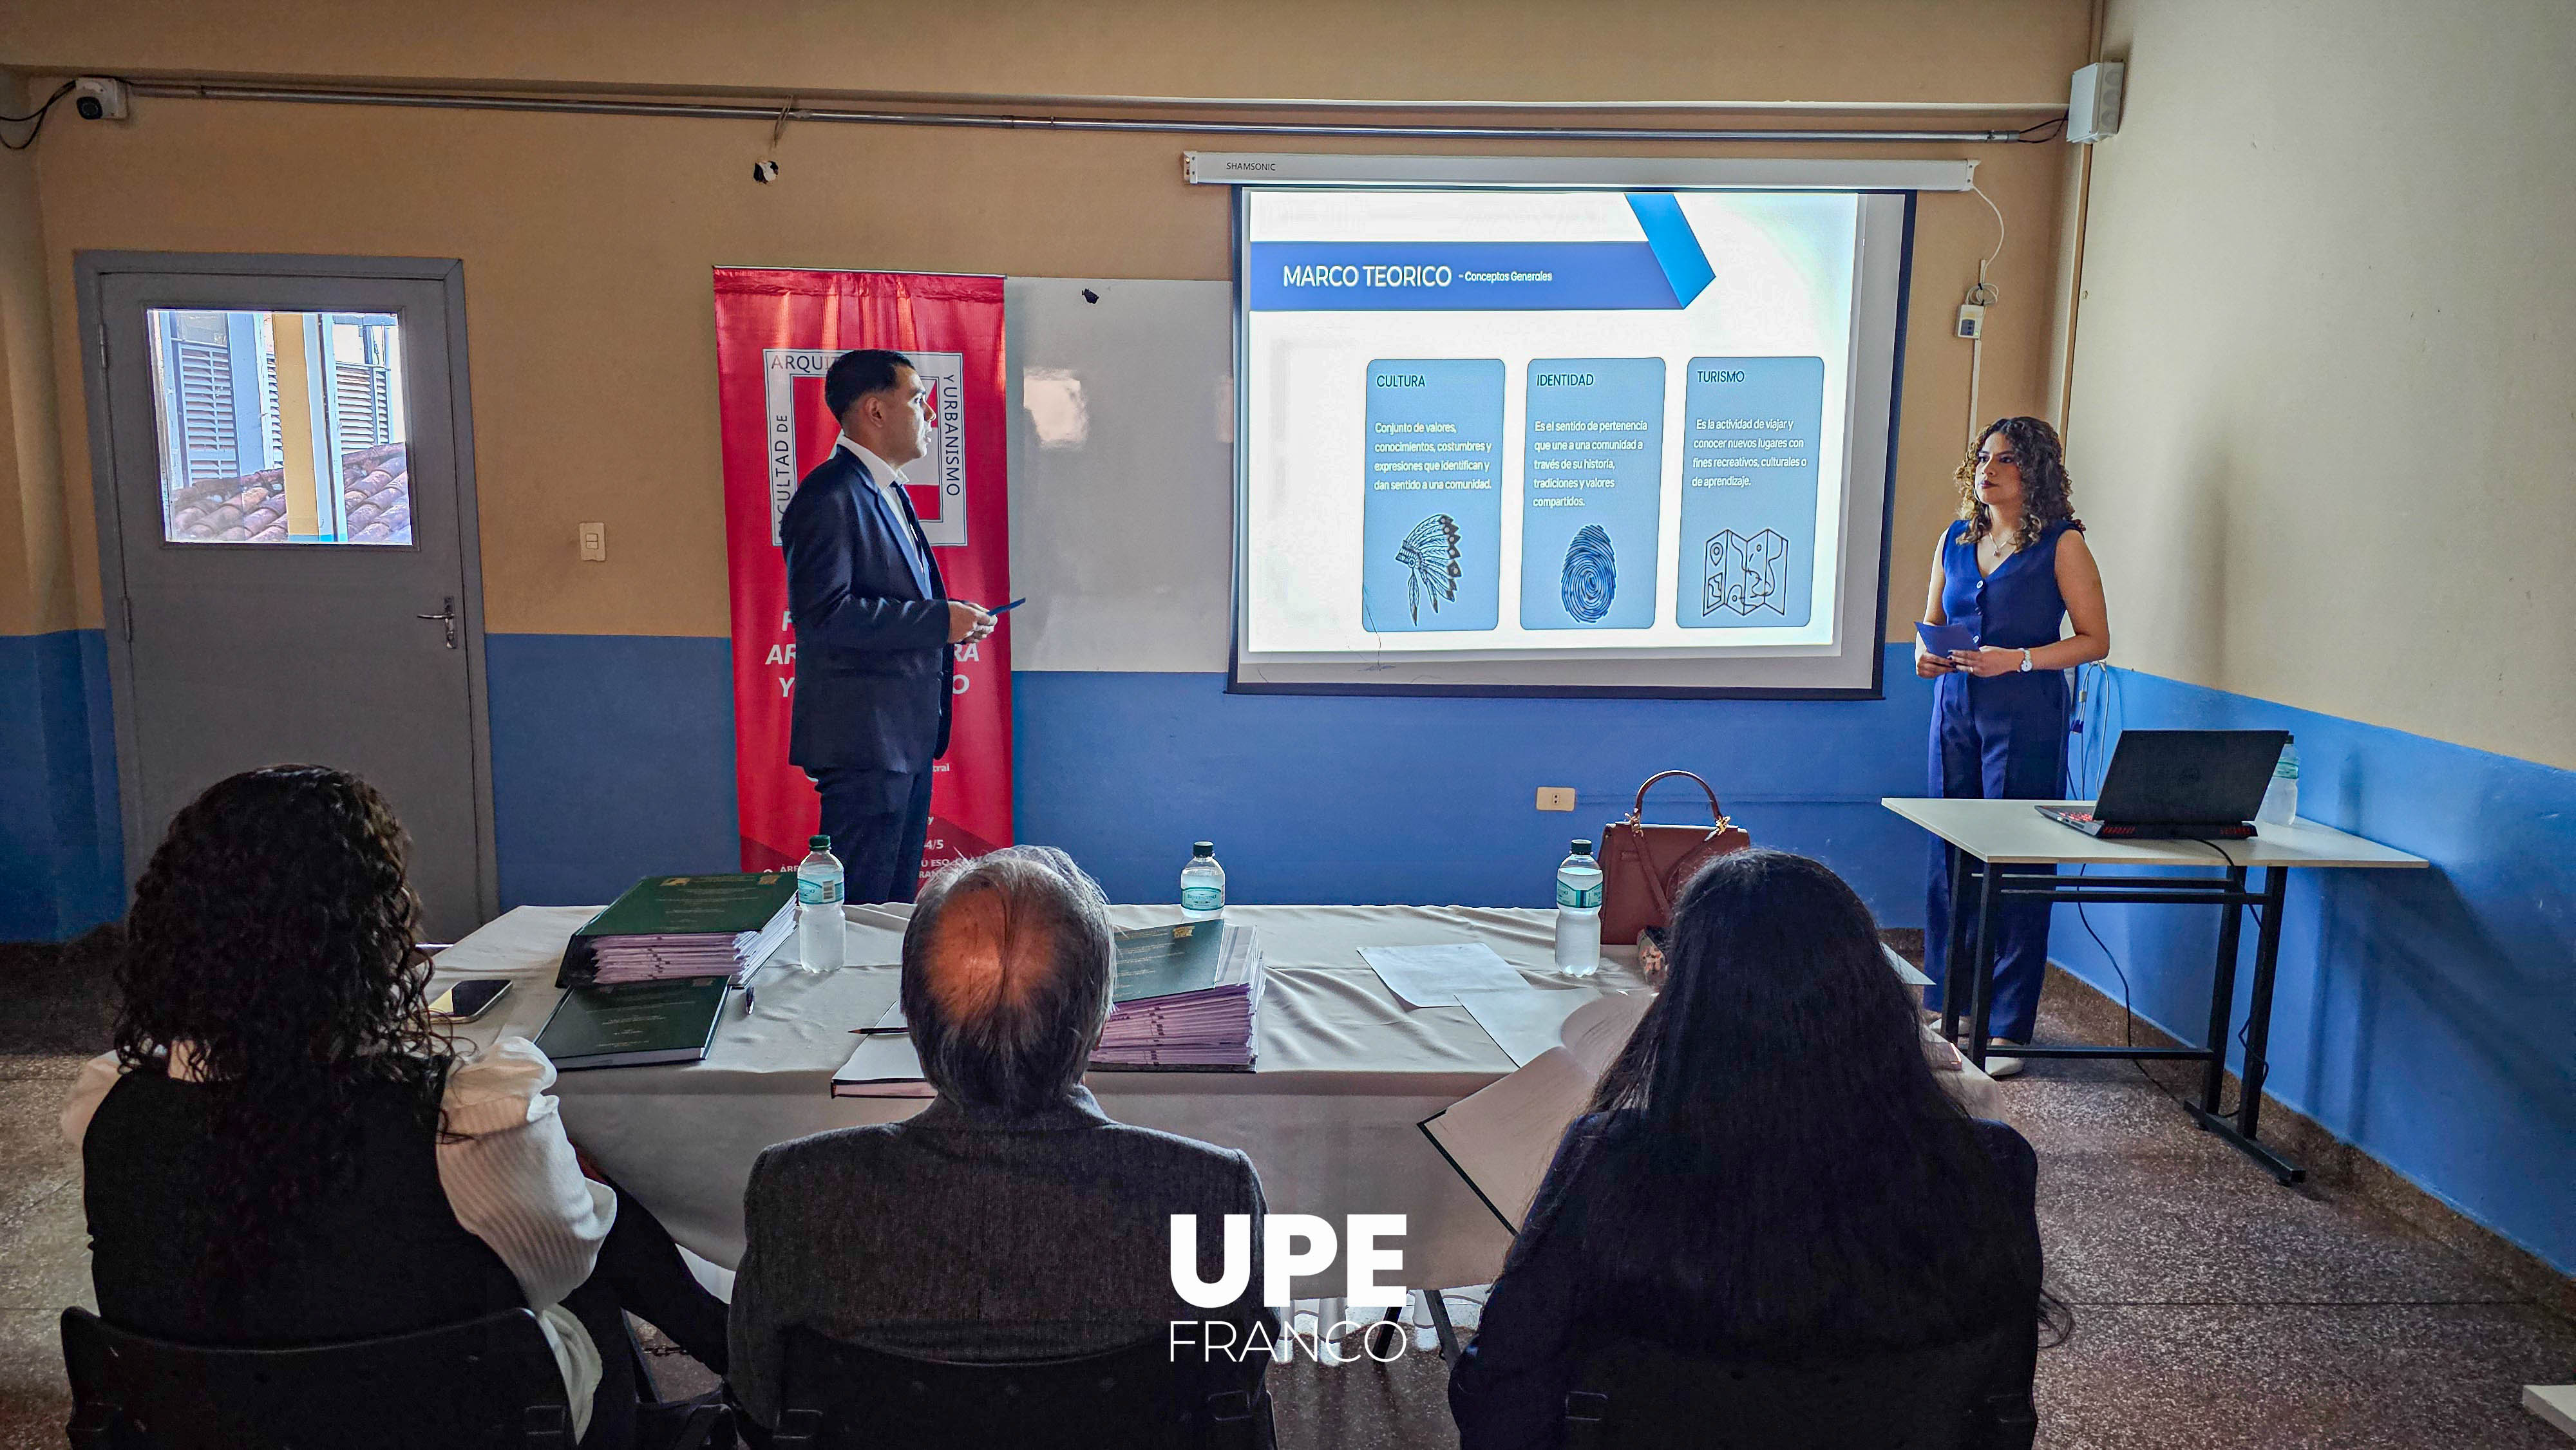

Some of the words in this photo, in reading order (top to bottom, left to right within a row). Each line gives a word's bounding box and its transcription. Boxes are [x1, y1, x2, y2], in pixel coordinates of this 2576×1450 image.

[1226, 162, 1276, 171] SHAMSONIC
[1283, 265, 1358, 287] MARCO
[1363, 265, 1452, 287] TEORICO
[1464, 270, 1510, 284] Conceptos
[1510, 270, 1552, 282] Generales
[1377, 375, 1425, 387] CULTURA
[1537, 374, 1594, 386] IDENTIDAD
[1698, 371, 1745, 382] TURISMO
[776, 415, 788, 433] DE
[1375, 422, 1412, 435] Conjunto
[1413, 422, 1425, 433] de
[1426, 422, 1457, 433] valores,
[1535, 421, 1545, 431] Es
[1546, 421, 1554, 431] el
[1555, 421, 1586, 431] sentido
[1587, 420, 1598, 431] de
[1599, 420, 1647, 433] pertenencia
[1696, 419, 1707, 429] Es
[1708, 419, 1715, 429] la
[1716, 419, 1752, 429] actividad
[1754, 419, 1765, 429] de
[1766, 419, 1787, 431] viajar
[1788, 420, 1794, 431] y
[943, 387, 960, 496] URBANISMO
[1375, 442, 1436, 453] conocimientos,
[1437, 442, 1485, 451] costumbres
[1486, 443, 1492, 453] y
[1535, 442, 1551, 452] que
[1552, 442, 1567, 450] une
[1569, 442, 1575, 450] a
[1575, 441, 1590, 450] una
[1591, 440, 1636, 449] comunidad
[1694, 439, 1727, 448] conocer
[1728, 439, 1757, 447] nuevos
[1758, 438, 1787, 450] lugares
[1788, 439, 1804, 447] con
[1374, 460, 1423, 473] expresiones
[1424, 462, 1440, 473] que
[1441, 460, 1483, 471] identifican
[1484, 462, 1490, 473] y
[1534, 458, 1560, 469] través
[1561, 459, 1572, 469] de
[1573, 460, 1583, 469] su
[1584, 458, 1615, 469] historia,
[1692, 457, 1712, 468] fines
[1714, 457, 1759, 468] recreativos,
[1761, 457, 1800, 467] culturales
[1801, 458, 1807, 467] o
[1374, 480, 1390, 490] dan
[1391, 480, 1421, 490] sentido
[1444, 479, 1492, 489] comunidad.
[1533, 478, 1578, 488] tradiciones
[1580, 480, 1586, 489] y
[1586, 478, 1615, 487] valores
[1692, 476, 1703, 487] de
[1704, 476, 1751, 488] aprendizaje.
[1533, 496, 1585, 509] compartidos.
[779, 677, 795, 697] Y
